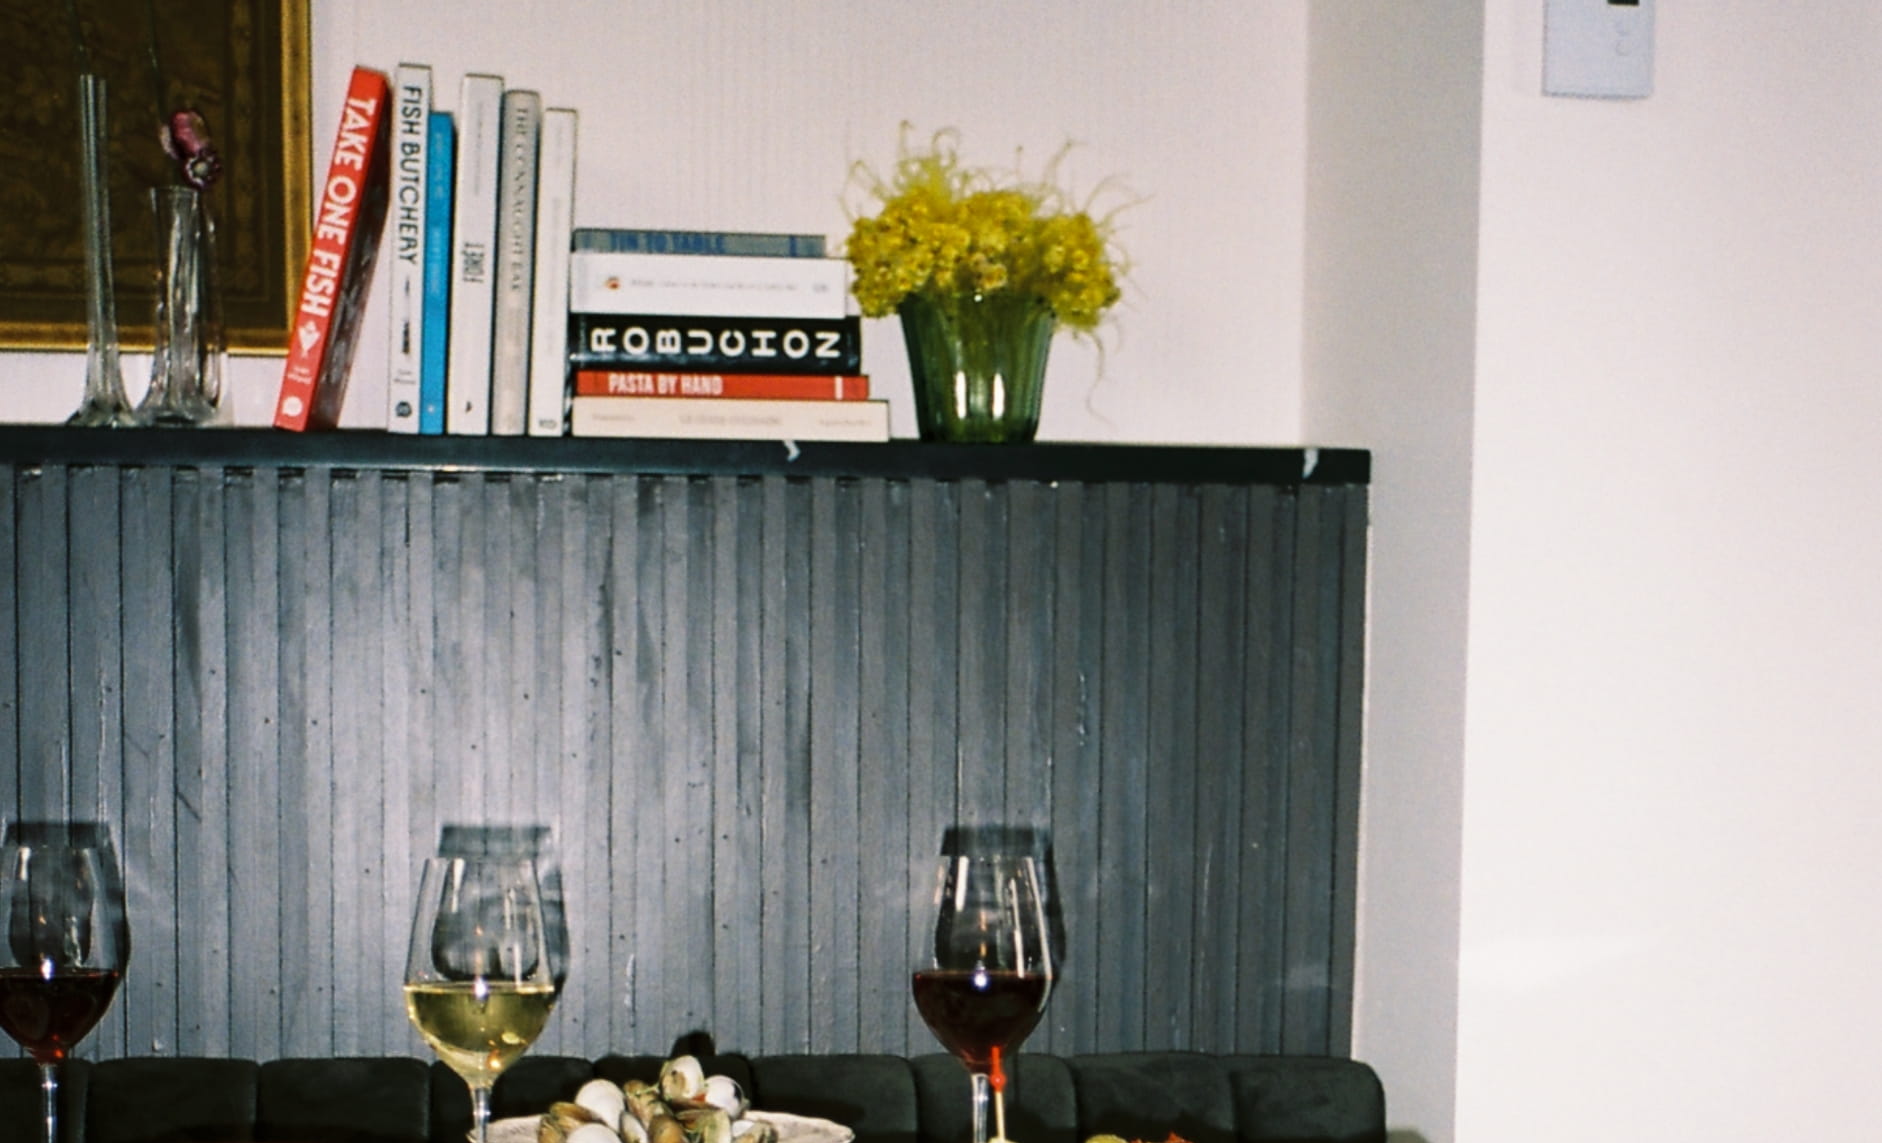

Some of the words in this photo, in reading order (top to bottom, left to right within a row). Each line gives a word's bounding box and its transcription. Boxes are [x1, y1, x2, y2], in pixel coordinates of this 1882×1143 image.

[335, 98, 376, 171] TAKE
[402, 86, 422, 135] FISH
[318, 176, 358, 246] ONE
[399, 142, 421, 265] BUTCHERY
[301, 249, 341, 317] FISH
[590, 326, 841, 359] ROBUCHON
[608, 373, 654, 394] PASTA
[657, 374, 679, 395] BY
[680, 375, 724, 396] HAND
